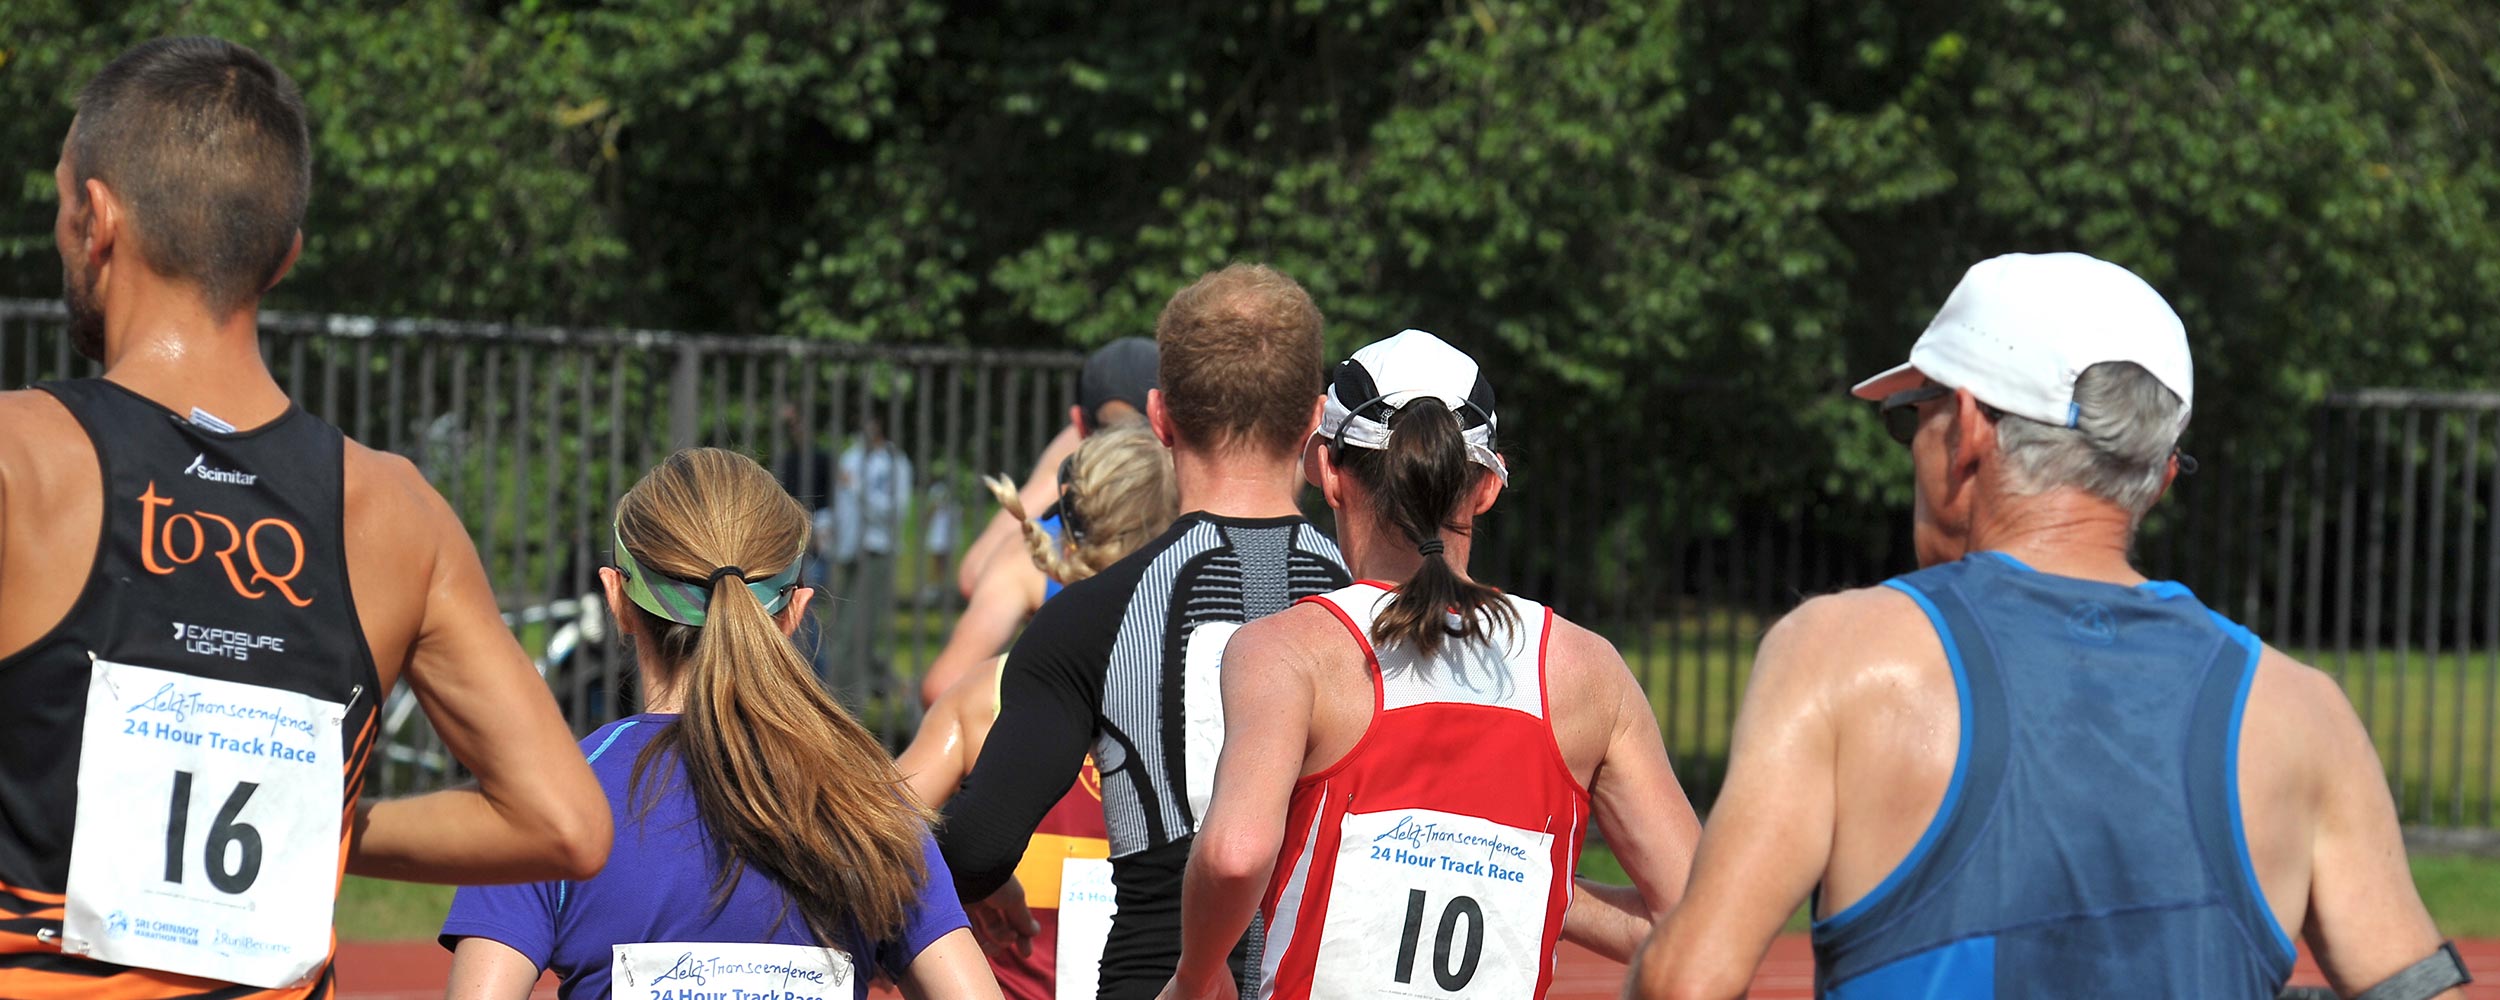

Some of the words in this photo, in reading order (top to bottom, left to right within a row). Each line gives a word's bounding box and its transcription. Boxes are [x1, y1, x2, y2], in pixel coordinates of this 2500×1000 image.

[196, 465, 258, 485] Scimitar
[186, 624, 285, 653] EXPOSURE
[186, 639, 249, 661] LIGHTS
[126, 683, 316, 737] Self-Transcendence
[123, 719, 149, 737] 24
[155, 722, 203, 746] Hour
[208, 732, 265, 756] Track
[270, 741, 316, 763] Race
[164, 769, 263, 895] 16
[1373, 815, 1527, 861] Self-Transcendence
[1370, 845, 1391, 861] 24
[1395, 848, 1436, 868] Hour
[1440, 855, 1484, 876] Track
[1488, 863, 1525, 883] Race
[134, 918, 150, 929] SRI
[152, 920, 199, 937] CHINMOY
[1394, 888, 1484, 992] 10
[651, 951, 824, 989] Self-Transcendence
[650, 989, 674, 1000] 24
[679, 988, 727, 1000] Hour
